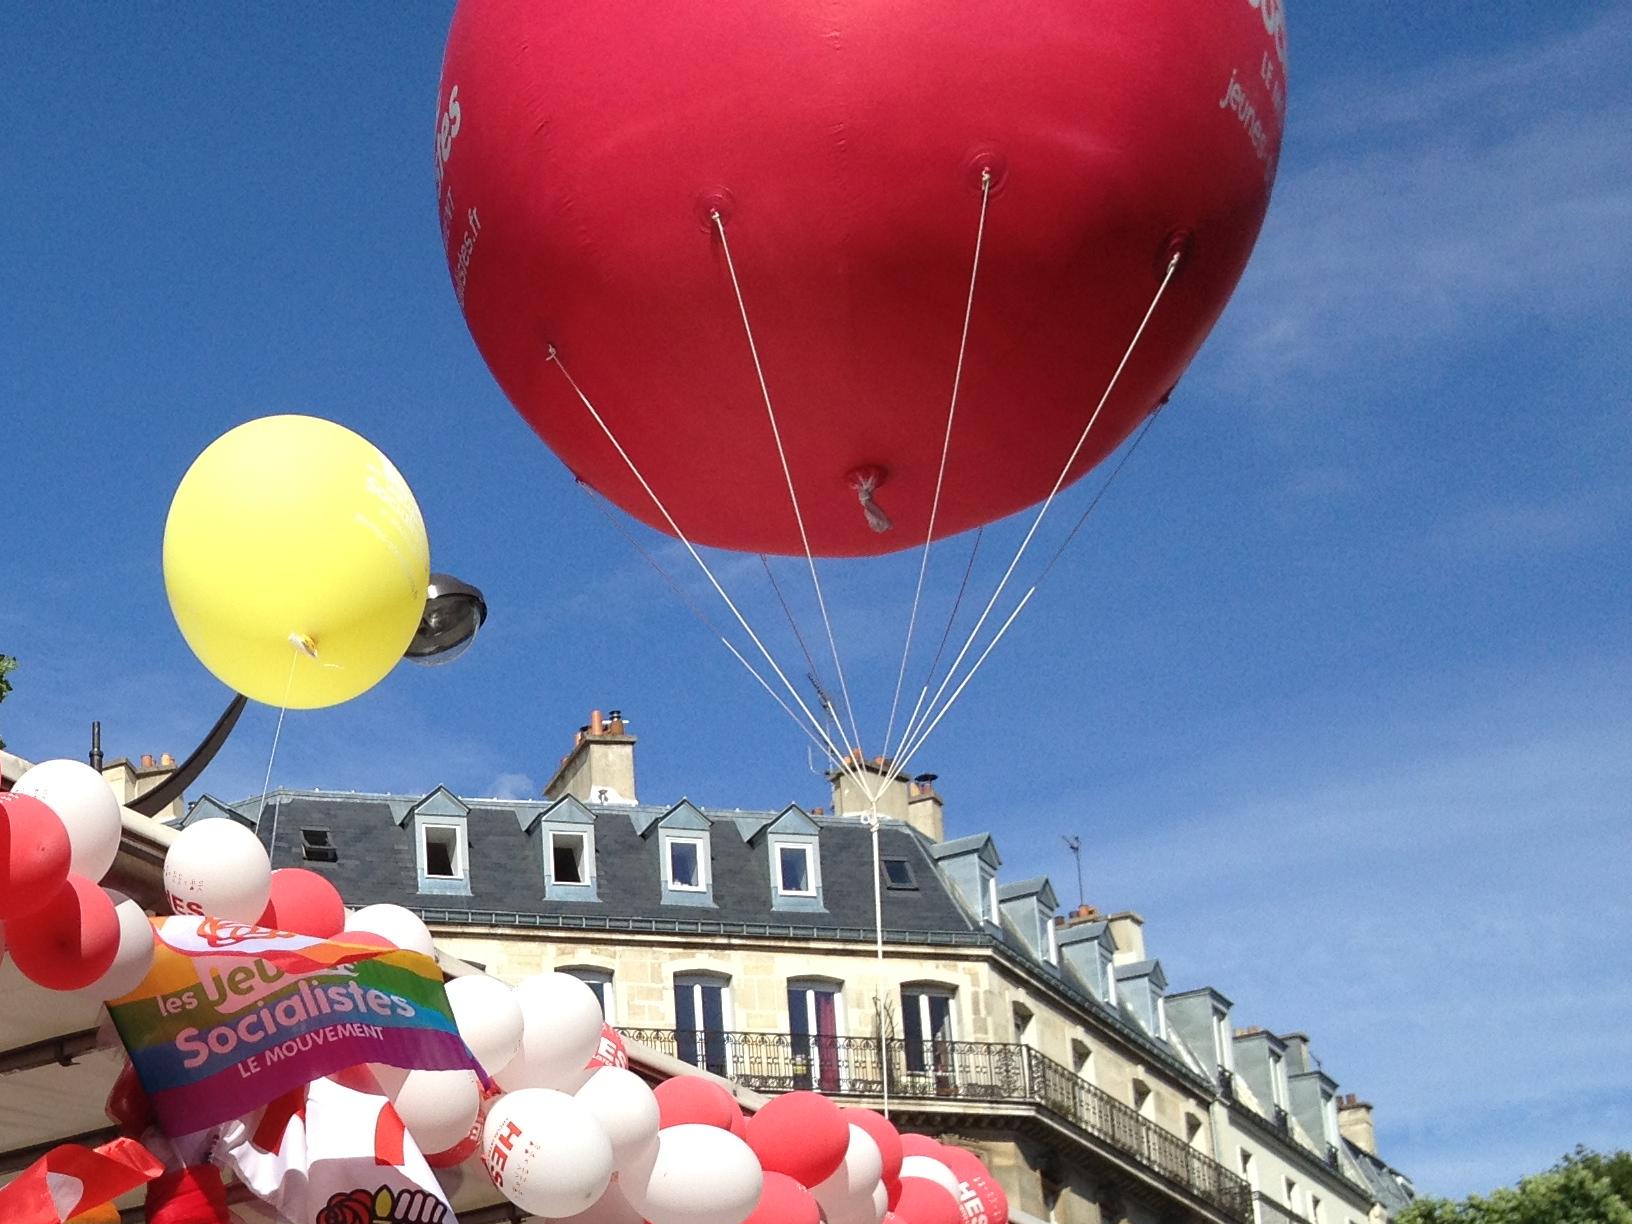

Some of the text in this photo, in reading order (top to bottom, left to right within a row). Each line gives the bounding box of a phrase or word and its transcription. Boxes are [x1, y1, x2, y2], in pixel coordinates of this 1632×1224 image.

[157, 991, 198, 1017] les
[175, 980, 416, 1069] Socialistes
[237, 1023, 386, 1079] LE MOUVEMENT
